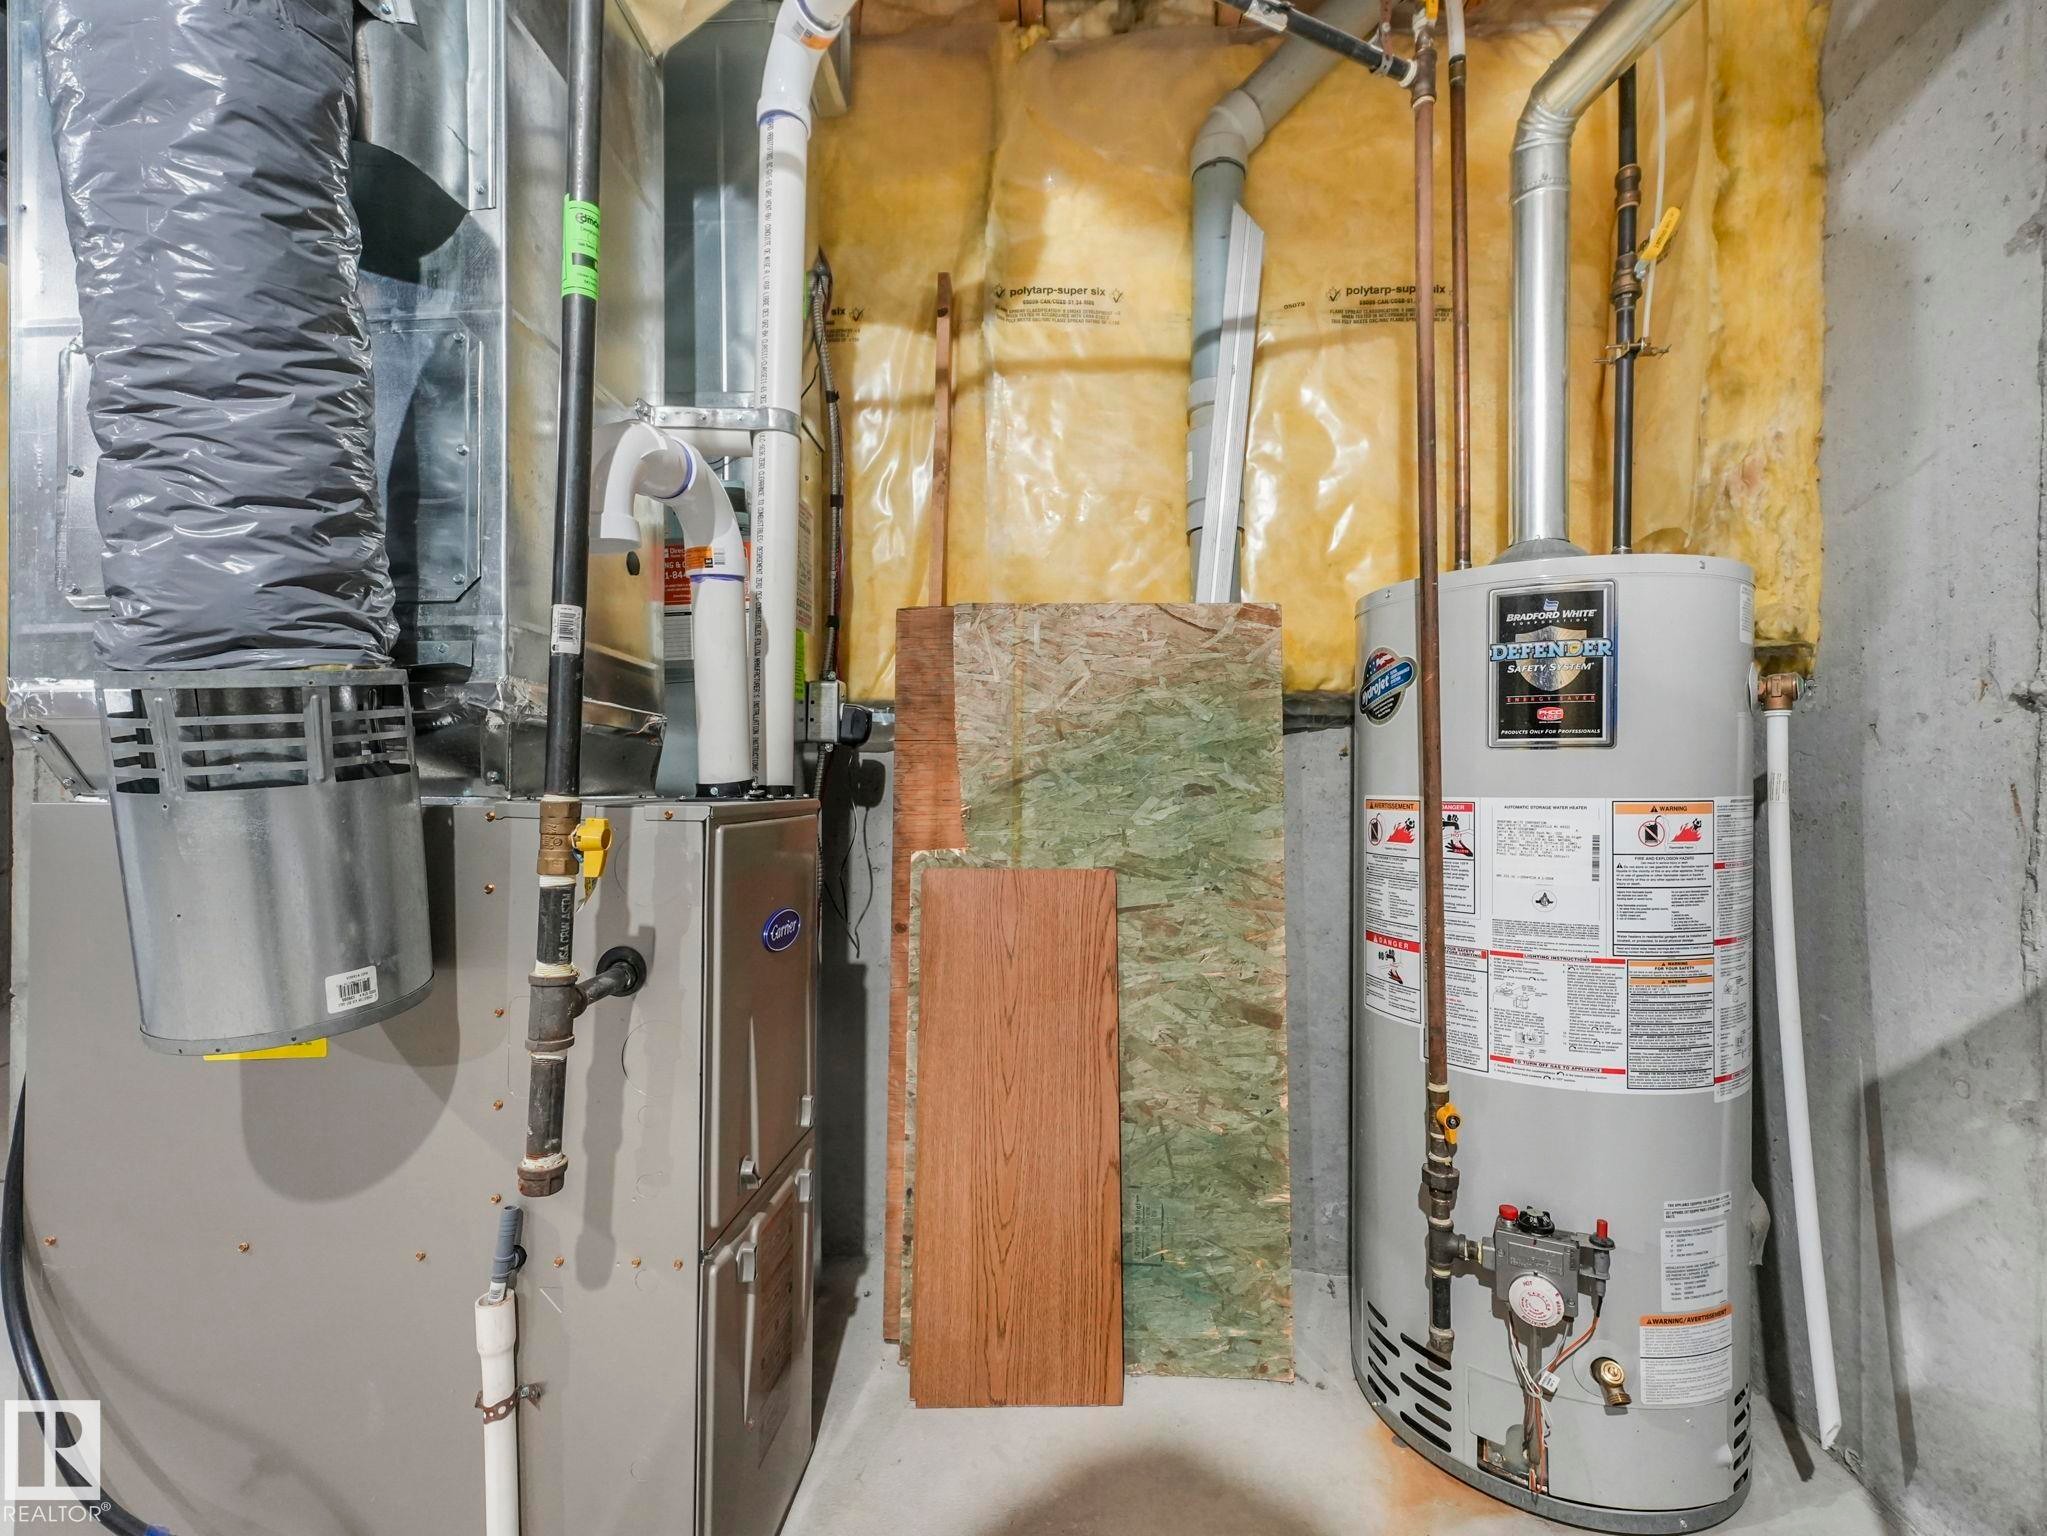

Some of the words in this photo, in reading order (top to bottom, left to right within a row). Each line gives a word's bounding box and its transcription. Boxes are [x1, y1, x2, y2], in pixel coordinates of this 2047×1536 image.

[1010, 286, 1088, 298] polytarp-super
[1091, 287, 1106, 296] six
[1506, 611, 1560, 622] BRADFORD
[1562, 609, 1597, 618] WHITE
[1490, 638, 1613, 661] DEFENDER
[1374, 803, 1414, 811] AVERTISSEMENT
[770, 919, 798, 942] Carrier
[1378, 937, 1409, 950] DANGER
